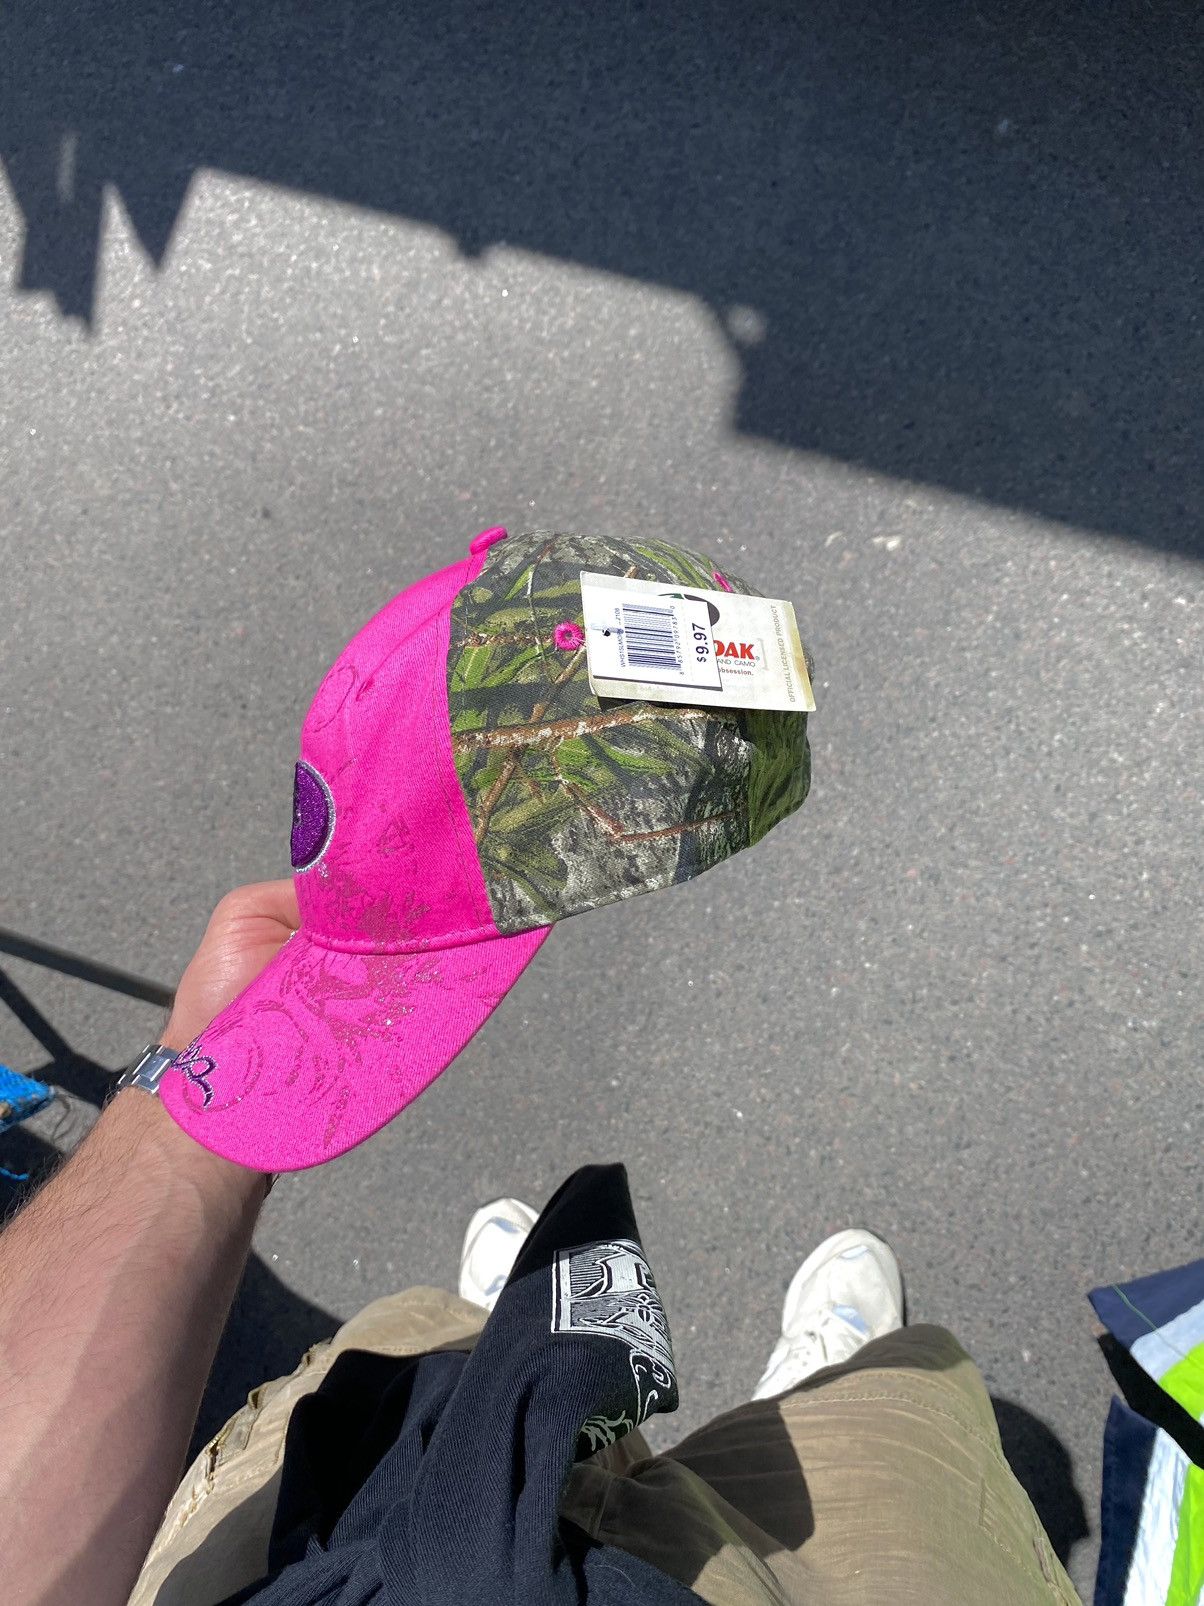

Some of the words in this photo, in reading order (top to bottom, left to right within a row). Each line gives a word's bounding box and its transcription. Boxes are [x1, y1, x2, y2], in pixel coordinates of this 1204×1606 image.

[770, 605, 782, 637] PRODUCT
[691, 622, 710, 663] $9.97
[778, 638, 790, 671] LICENSED
[734, 659, 756, 668] CAMO
[784, 672, 796, 703] OFFICIAL
